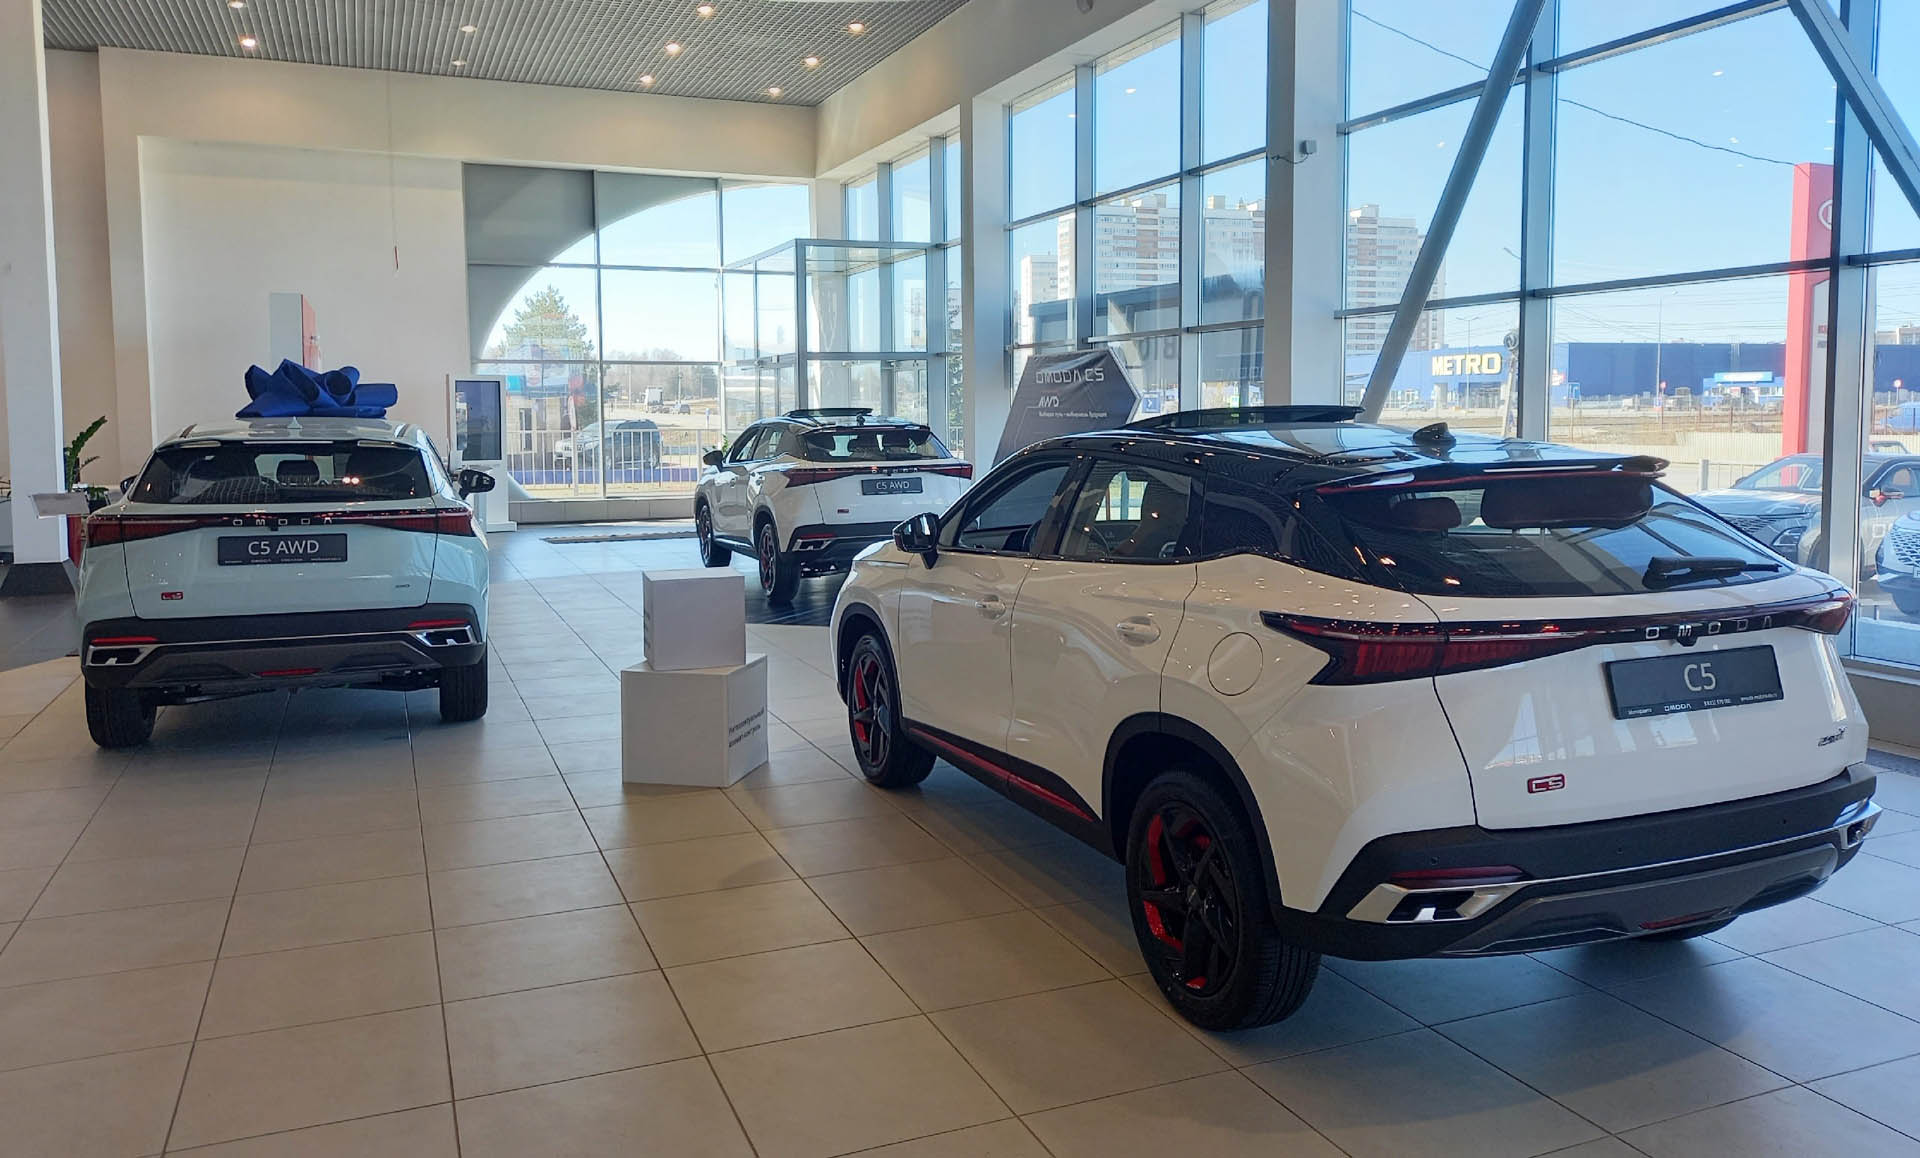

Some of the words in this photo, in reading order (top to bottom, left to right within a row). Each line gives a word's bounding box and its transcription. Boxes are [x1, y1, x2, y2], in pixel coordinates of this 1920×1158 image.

[1431, 352, 1502, 377] METRO
[1035, 368, 1083, 384] OMODA
[1084, 367, 1105, 382] C5
[1038, 395, 1060, 409] AWD
[876, 482, 887, 490] C5
[889, 481, 910, 489] AWD
[232, 516, 333, 527] OMODA
[247, 541, 270, 556] C5
[275, 539, 320, 554] AWD
[1645, 615, 1773, 640] OMODA
[1683, 662, 1717, 692] C5
[1664, 703, 1692, 712] OMODA
[1532, 776, 1563, 792] C5
